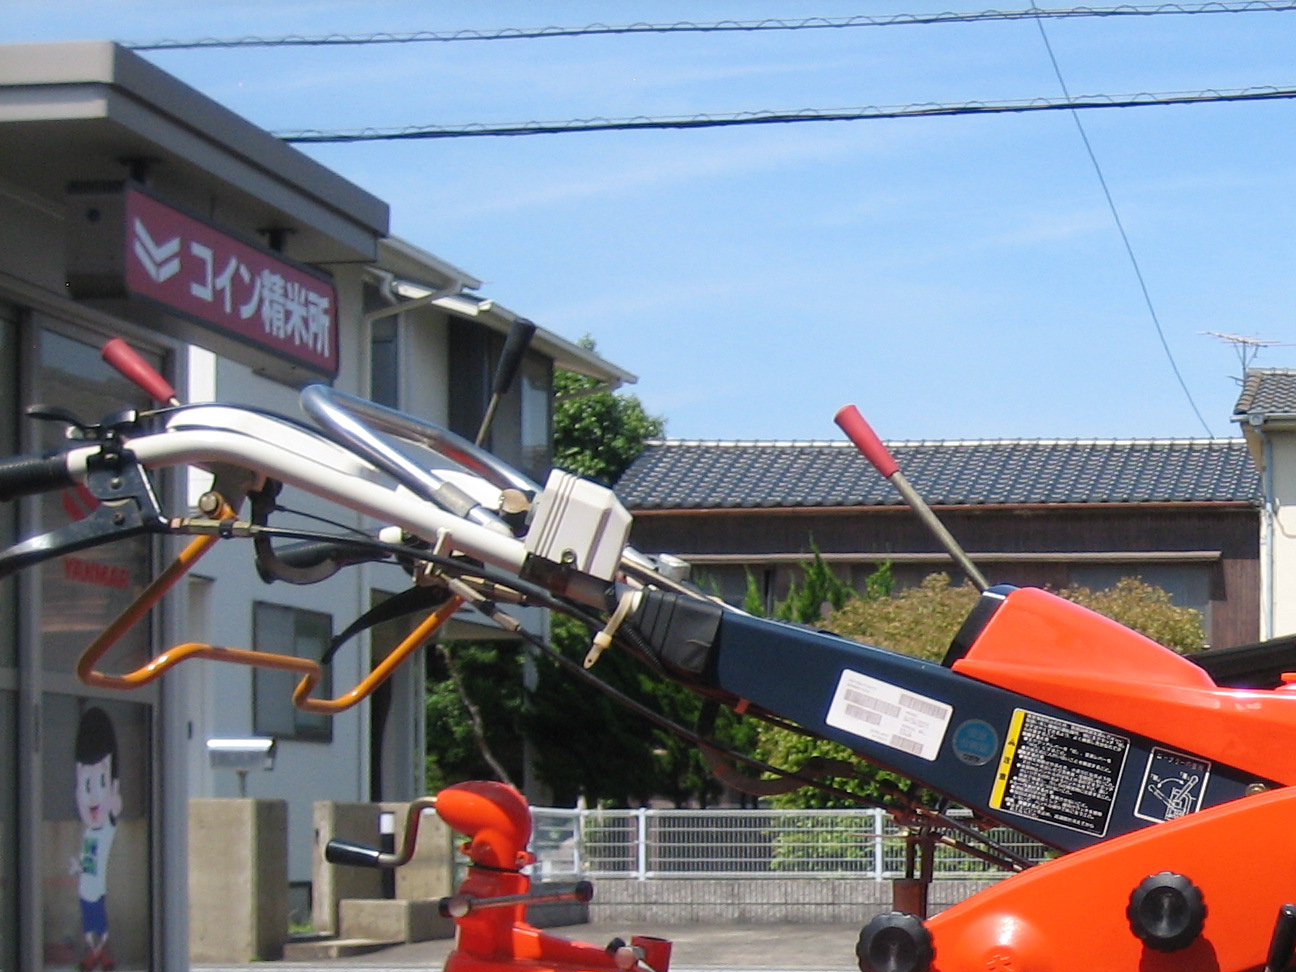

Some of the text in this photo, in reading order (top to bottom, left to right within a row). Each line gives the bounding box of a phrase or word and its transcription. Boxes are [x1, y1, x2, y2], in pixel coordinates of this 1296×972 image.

[189, 240, 330, 358] コイン精米所
